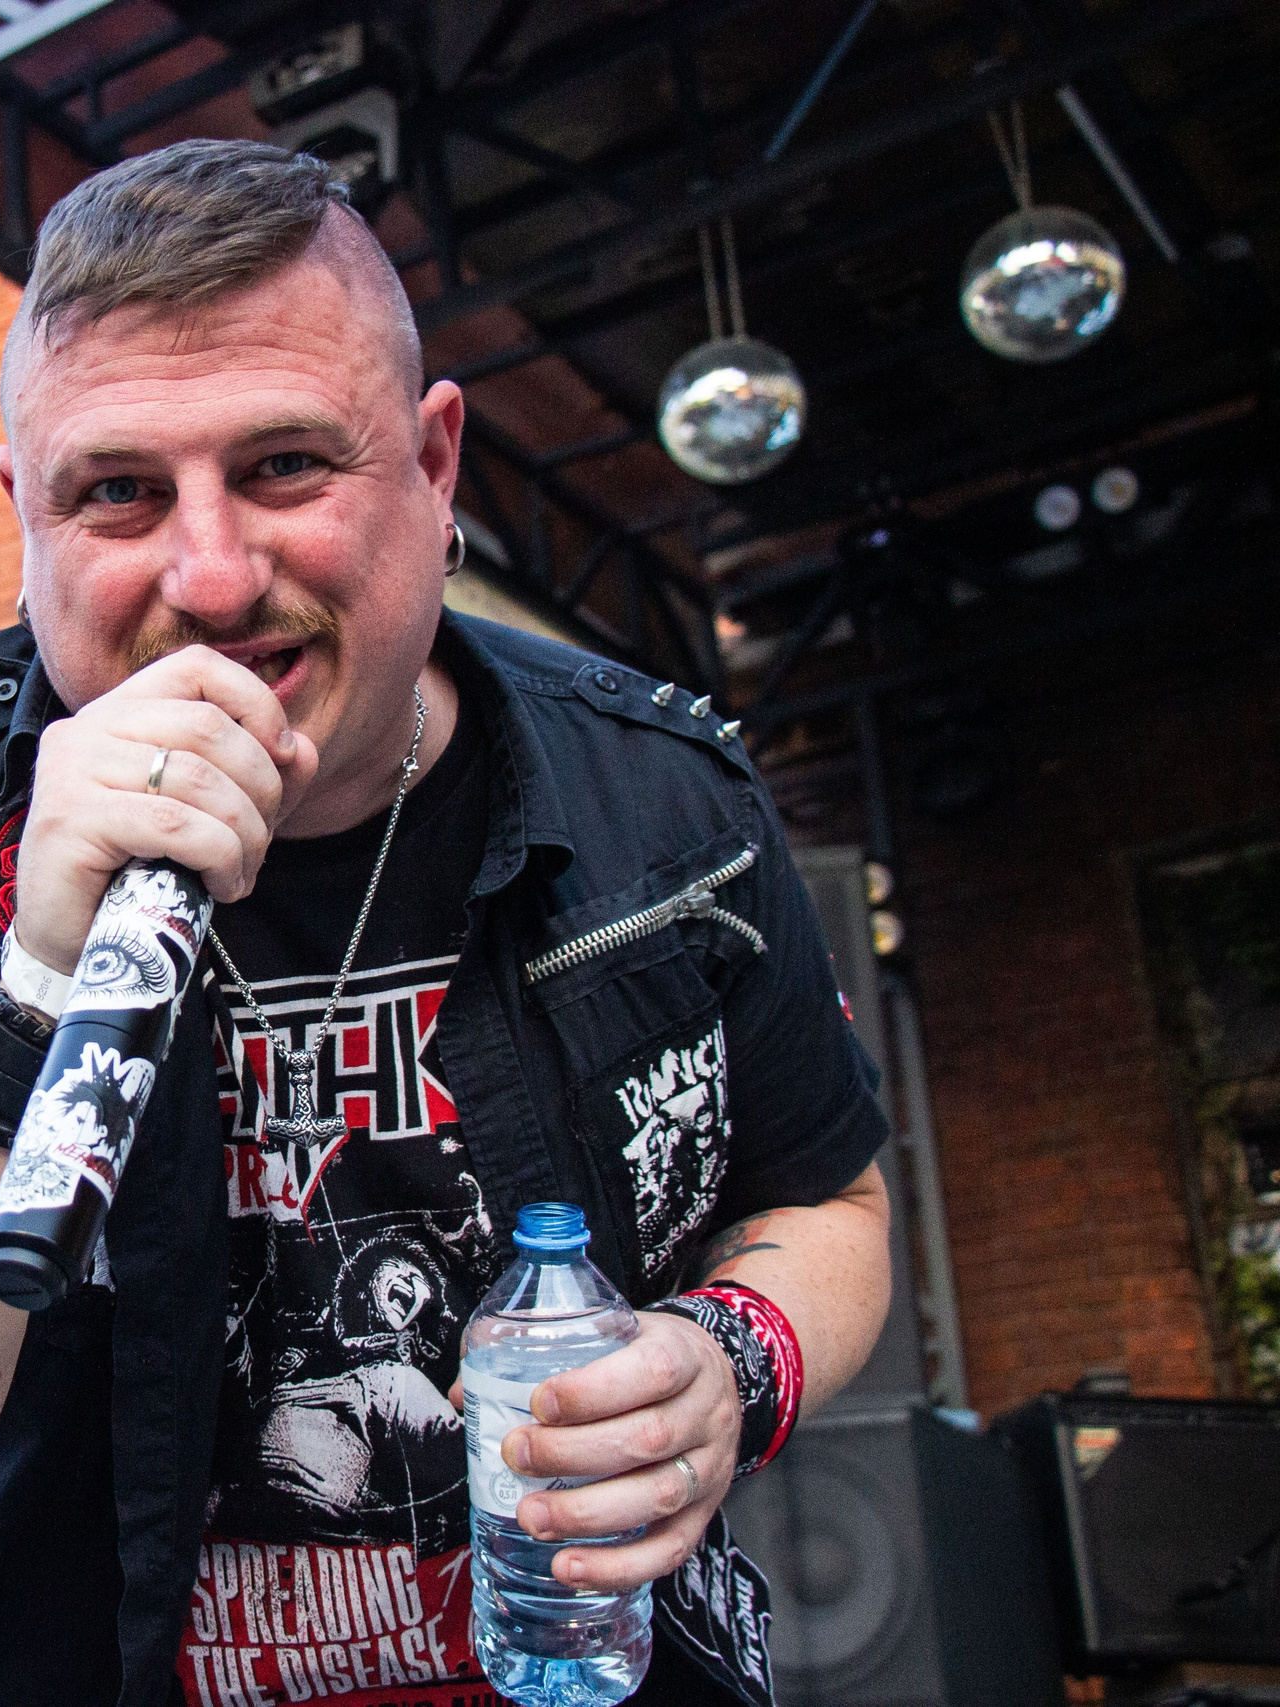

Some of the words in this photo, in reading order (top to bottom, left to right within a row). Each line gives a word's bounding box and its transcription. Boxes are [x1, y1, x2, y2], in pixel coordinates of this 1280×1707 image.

[191, 1543, 424, 1645] SPREADING
[186, 1645, 277, 1707] THE
[275, 1612, 458, 1701] DISEASE
